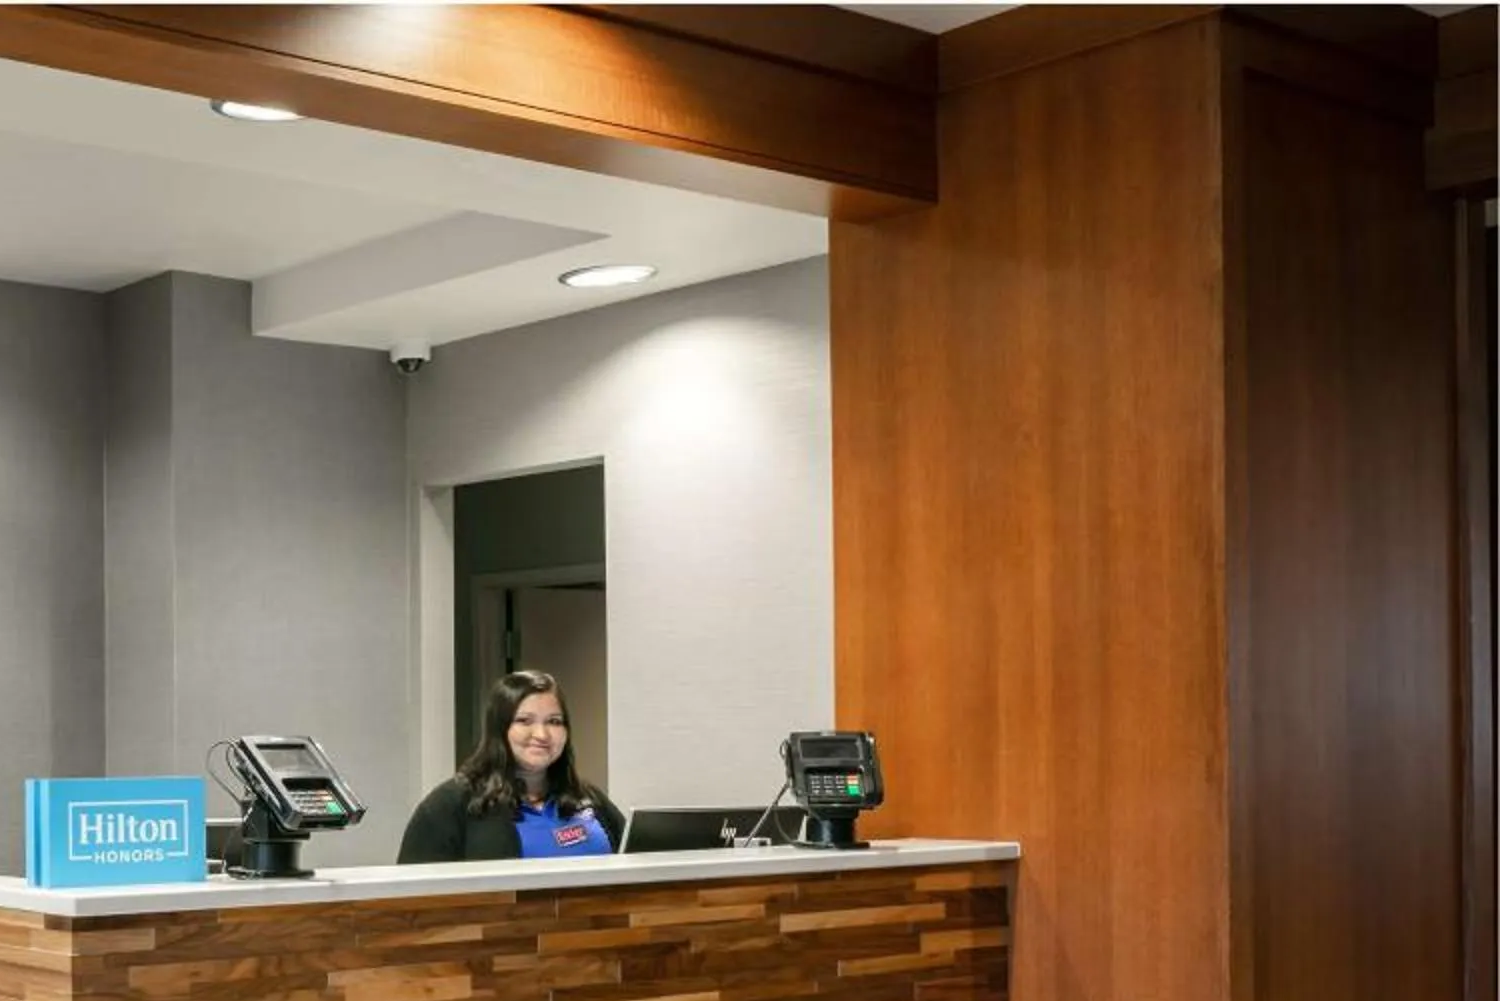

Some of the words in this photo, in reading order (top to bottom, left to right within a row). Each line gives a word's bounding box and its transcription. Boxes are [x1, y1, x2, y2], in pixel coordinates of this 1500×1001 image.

[79, 813, 178, 845] Hilton
[719, 818, 737, 848] hp
[94, 848, 165, 864] HONORS
